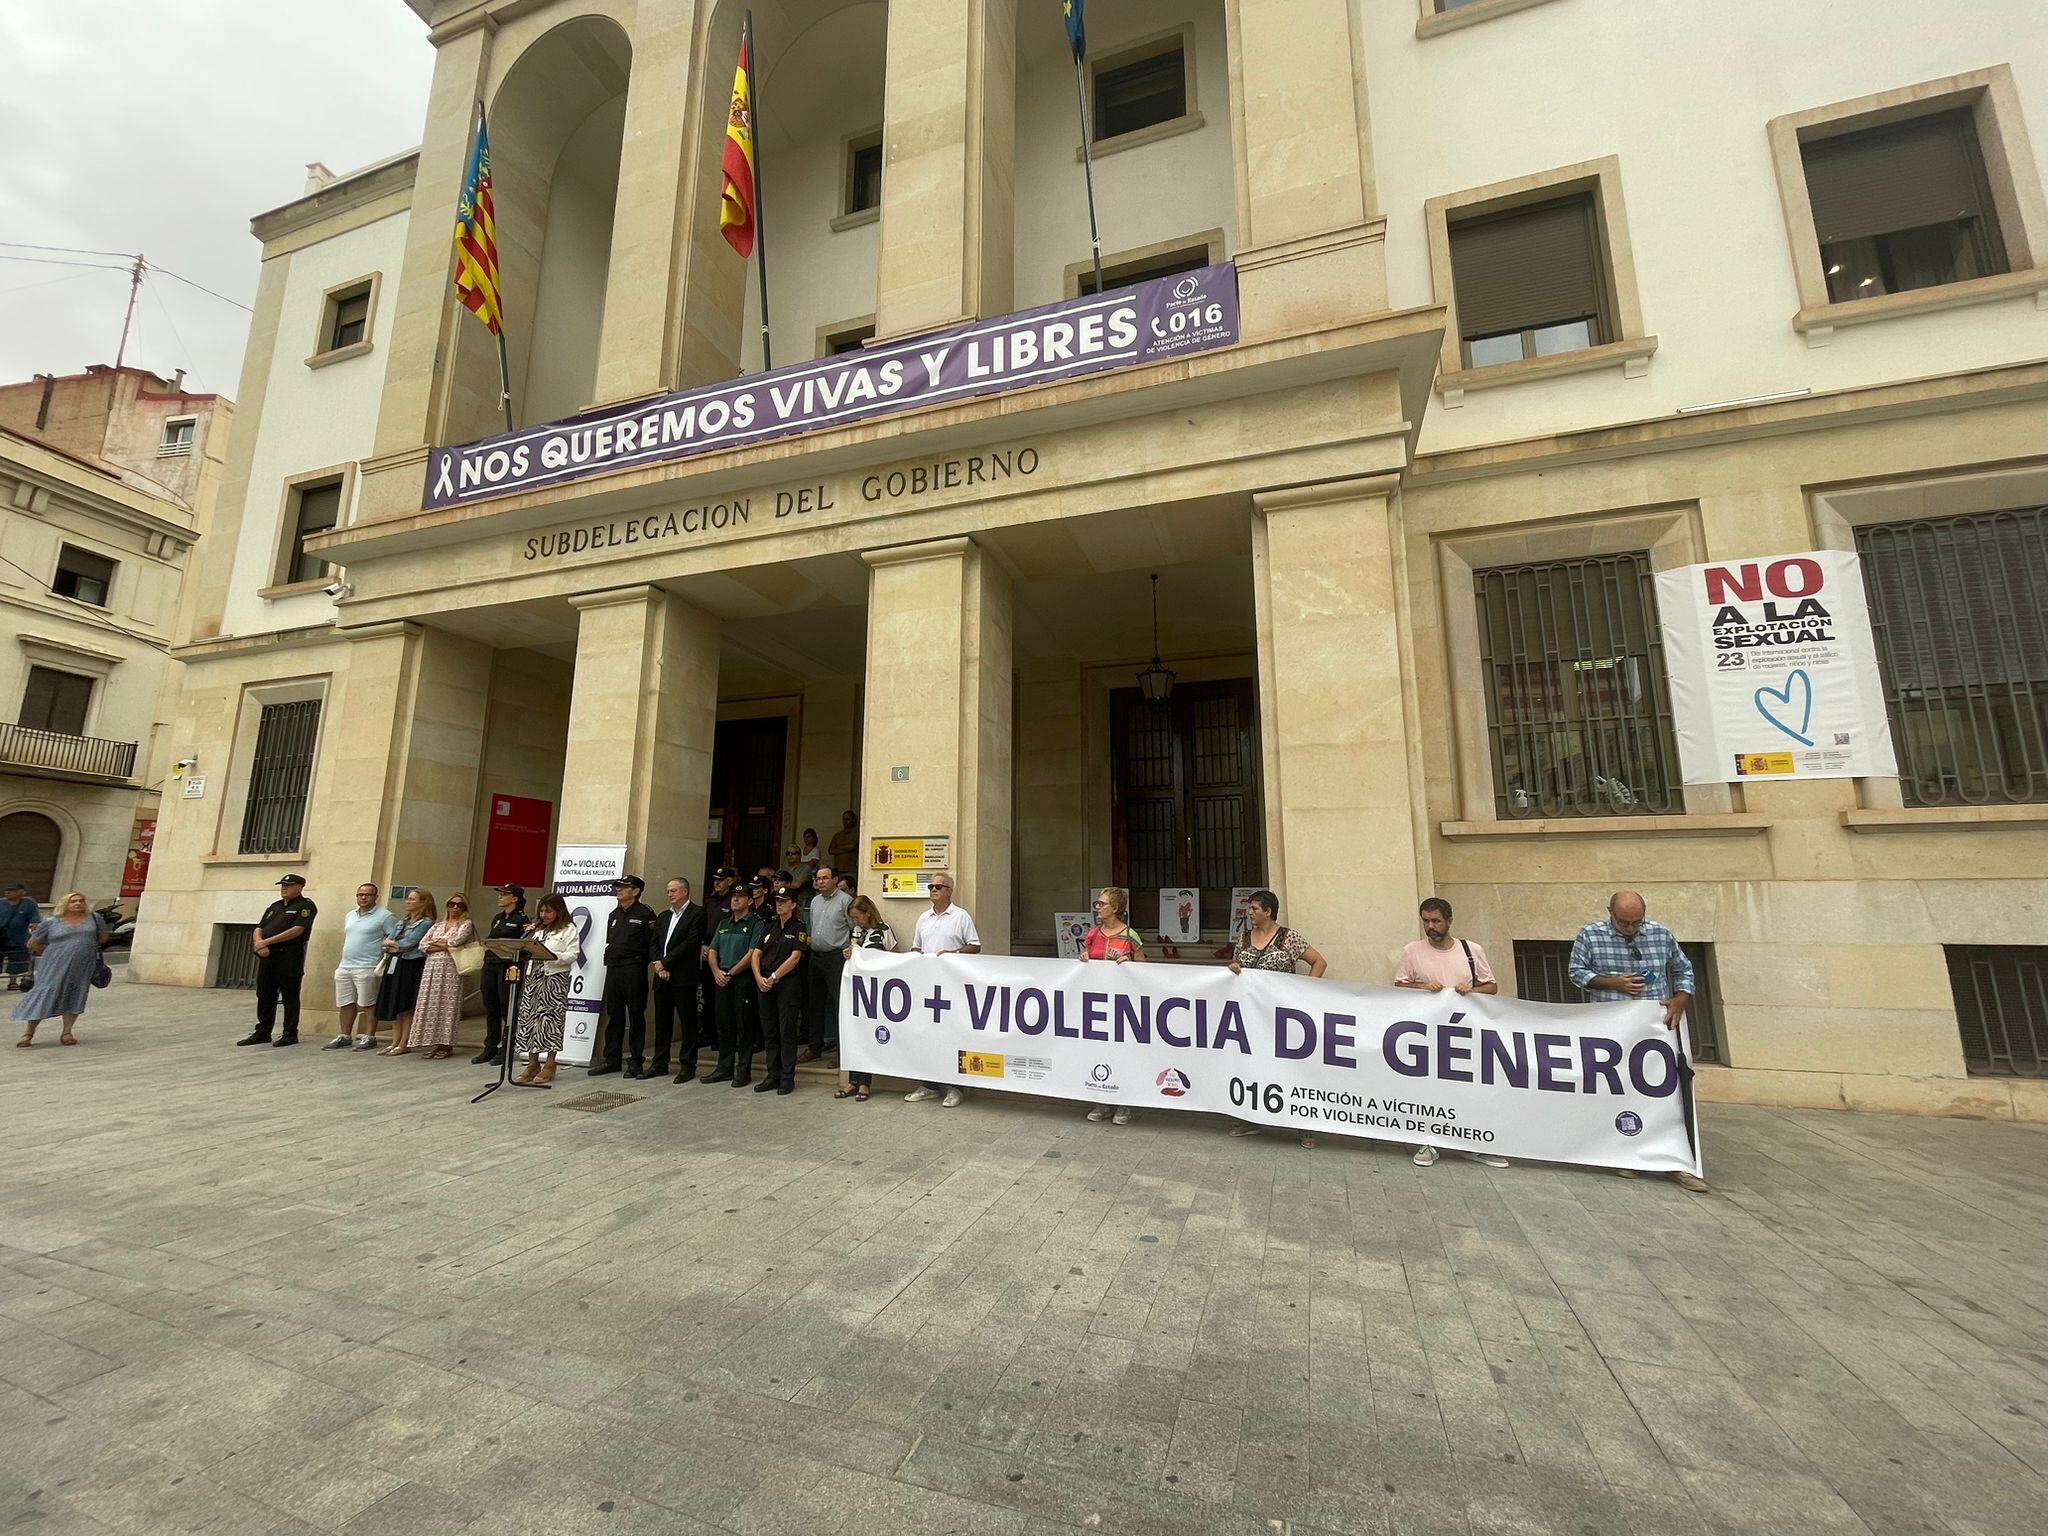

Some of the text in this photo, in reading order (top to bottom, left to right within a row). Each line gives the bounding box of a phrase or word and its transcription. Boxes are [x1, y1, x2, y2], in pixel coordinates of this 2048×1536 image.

[1169, 303, 1223, 333] 016
[1153, 332, 1185, 346] ATENCIÓN
[1192, 326, 1223, 337] VÍCTIMAS
[1156, 340, 1191, 352] VIOLENCIA
[1202, 330, 1230, 341] GÉNERO
[460, 308, 1138, 488] NOS QUEREMOS VIVAS Y LIBRES
[524, 448, 1039, 560] SUBDELEGACION DEL GOBIERNO
[1704, 558, 1824, 606] NO
[1712, 598, 1832, 627] A LA
[1712, 618, 1833, 636] EXPLOTACIÓN
[1714, 628, 1836, 650] SEXUAL
[1716, 652, 1746, 668] 23
[898, 770, 903, 780] 6
[561, 860, 573, 868] NO
[578, 860, 616, 868] VIOLENCIA
[556, 884, 612, 894] NI UNA MENOS
[852, 974, 1678, 1098] NO + VIOLENCIA DE GÉNERO
[1230, 1076, 1284, 1114] 016
[1290, 1086, 1456, 1120] ATENCIÓN A VÍCTIMAS
[1290, 1104, 1495, 1142] POR VIOLENCIA DE GÉNERO
